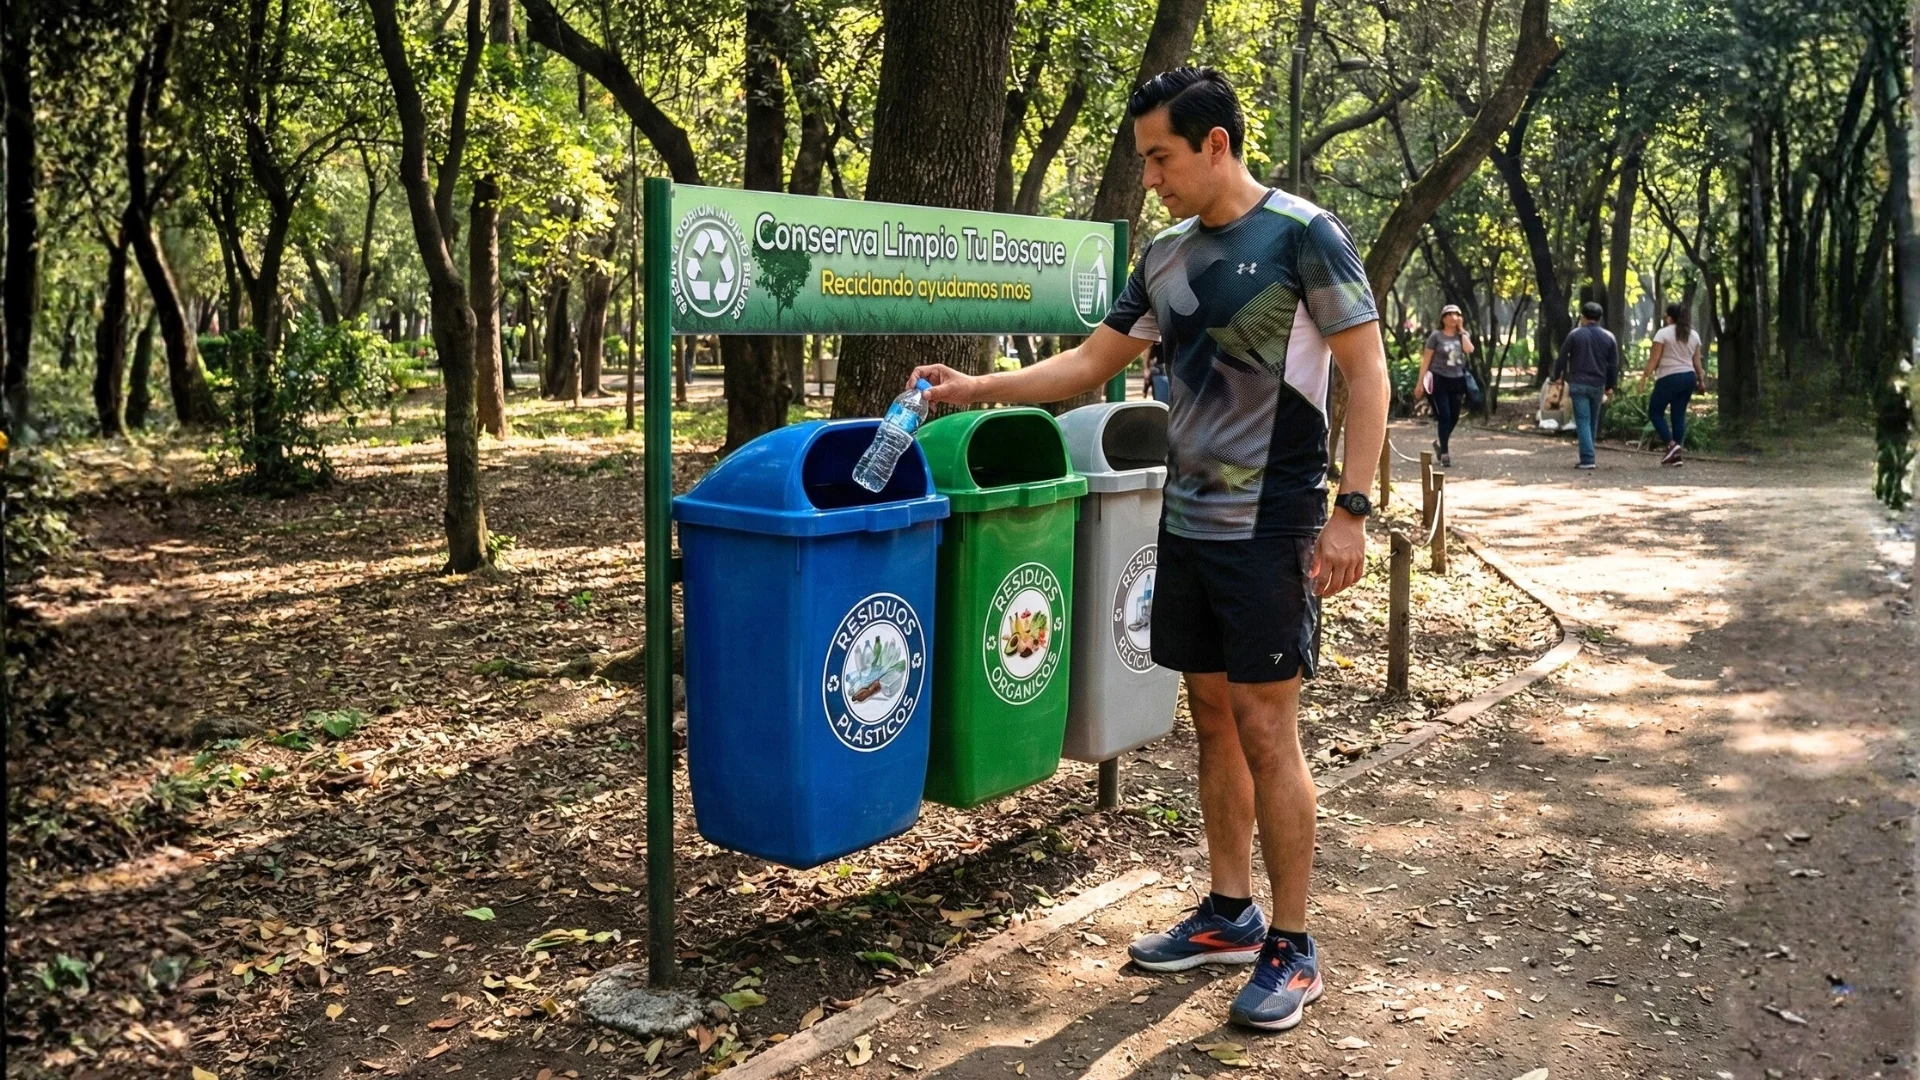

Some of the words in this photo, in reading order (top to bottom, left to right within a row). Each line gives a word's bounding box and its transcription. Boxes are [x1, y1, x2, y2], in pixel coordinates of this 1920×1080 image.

[756, 214, 878, 257] Conserva
[883, 222, 959, 265] Limpio
[963, 228, 988, 260] Tu
[992, 230, 1066, 271] Bosque
[822, 269, 914, 297] Reciclando
[995, 569, 1058, 612] RESIDUOS
[836, 600, 916, 650] RESIDUOS
[836, 694, 913, 745] PLÁSTICOS
